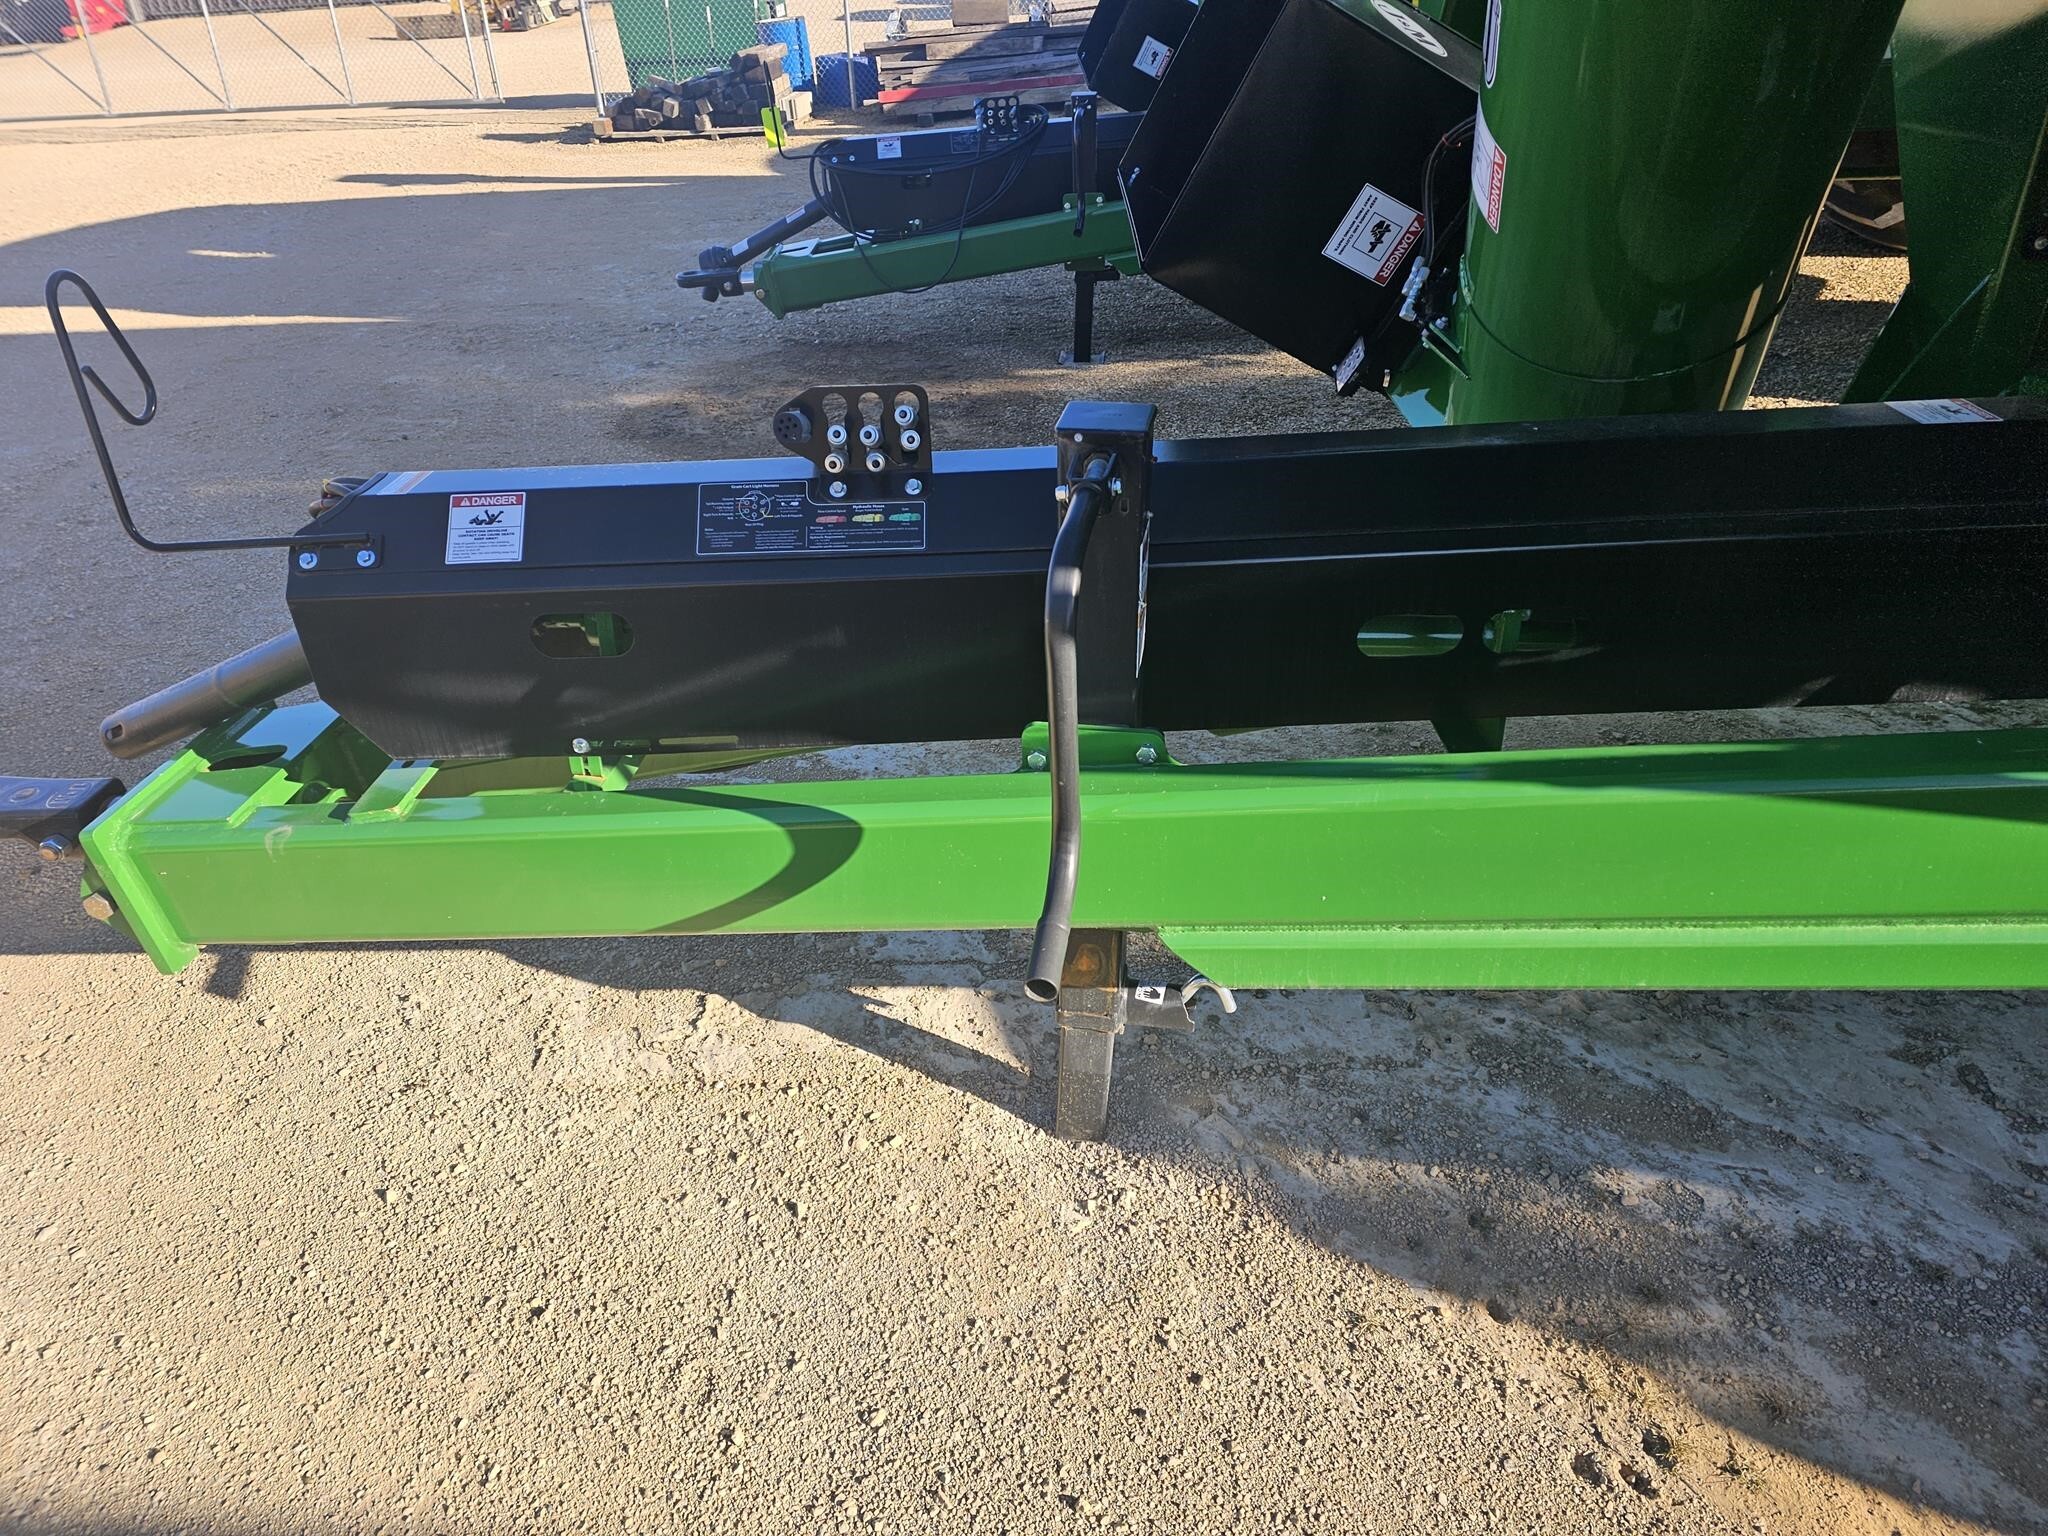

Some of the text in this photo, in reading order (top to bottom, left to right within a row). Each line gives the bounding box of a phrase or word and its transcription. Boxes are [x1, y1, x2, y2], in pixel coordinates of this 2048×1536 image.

[1487, 166, 1502, 229] DANGER
[1379, 233, 1415, 277] DANGER
[471, 496, 517, 506] DANGER
